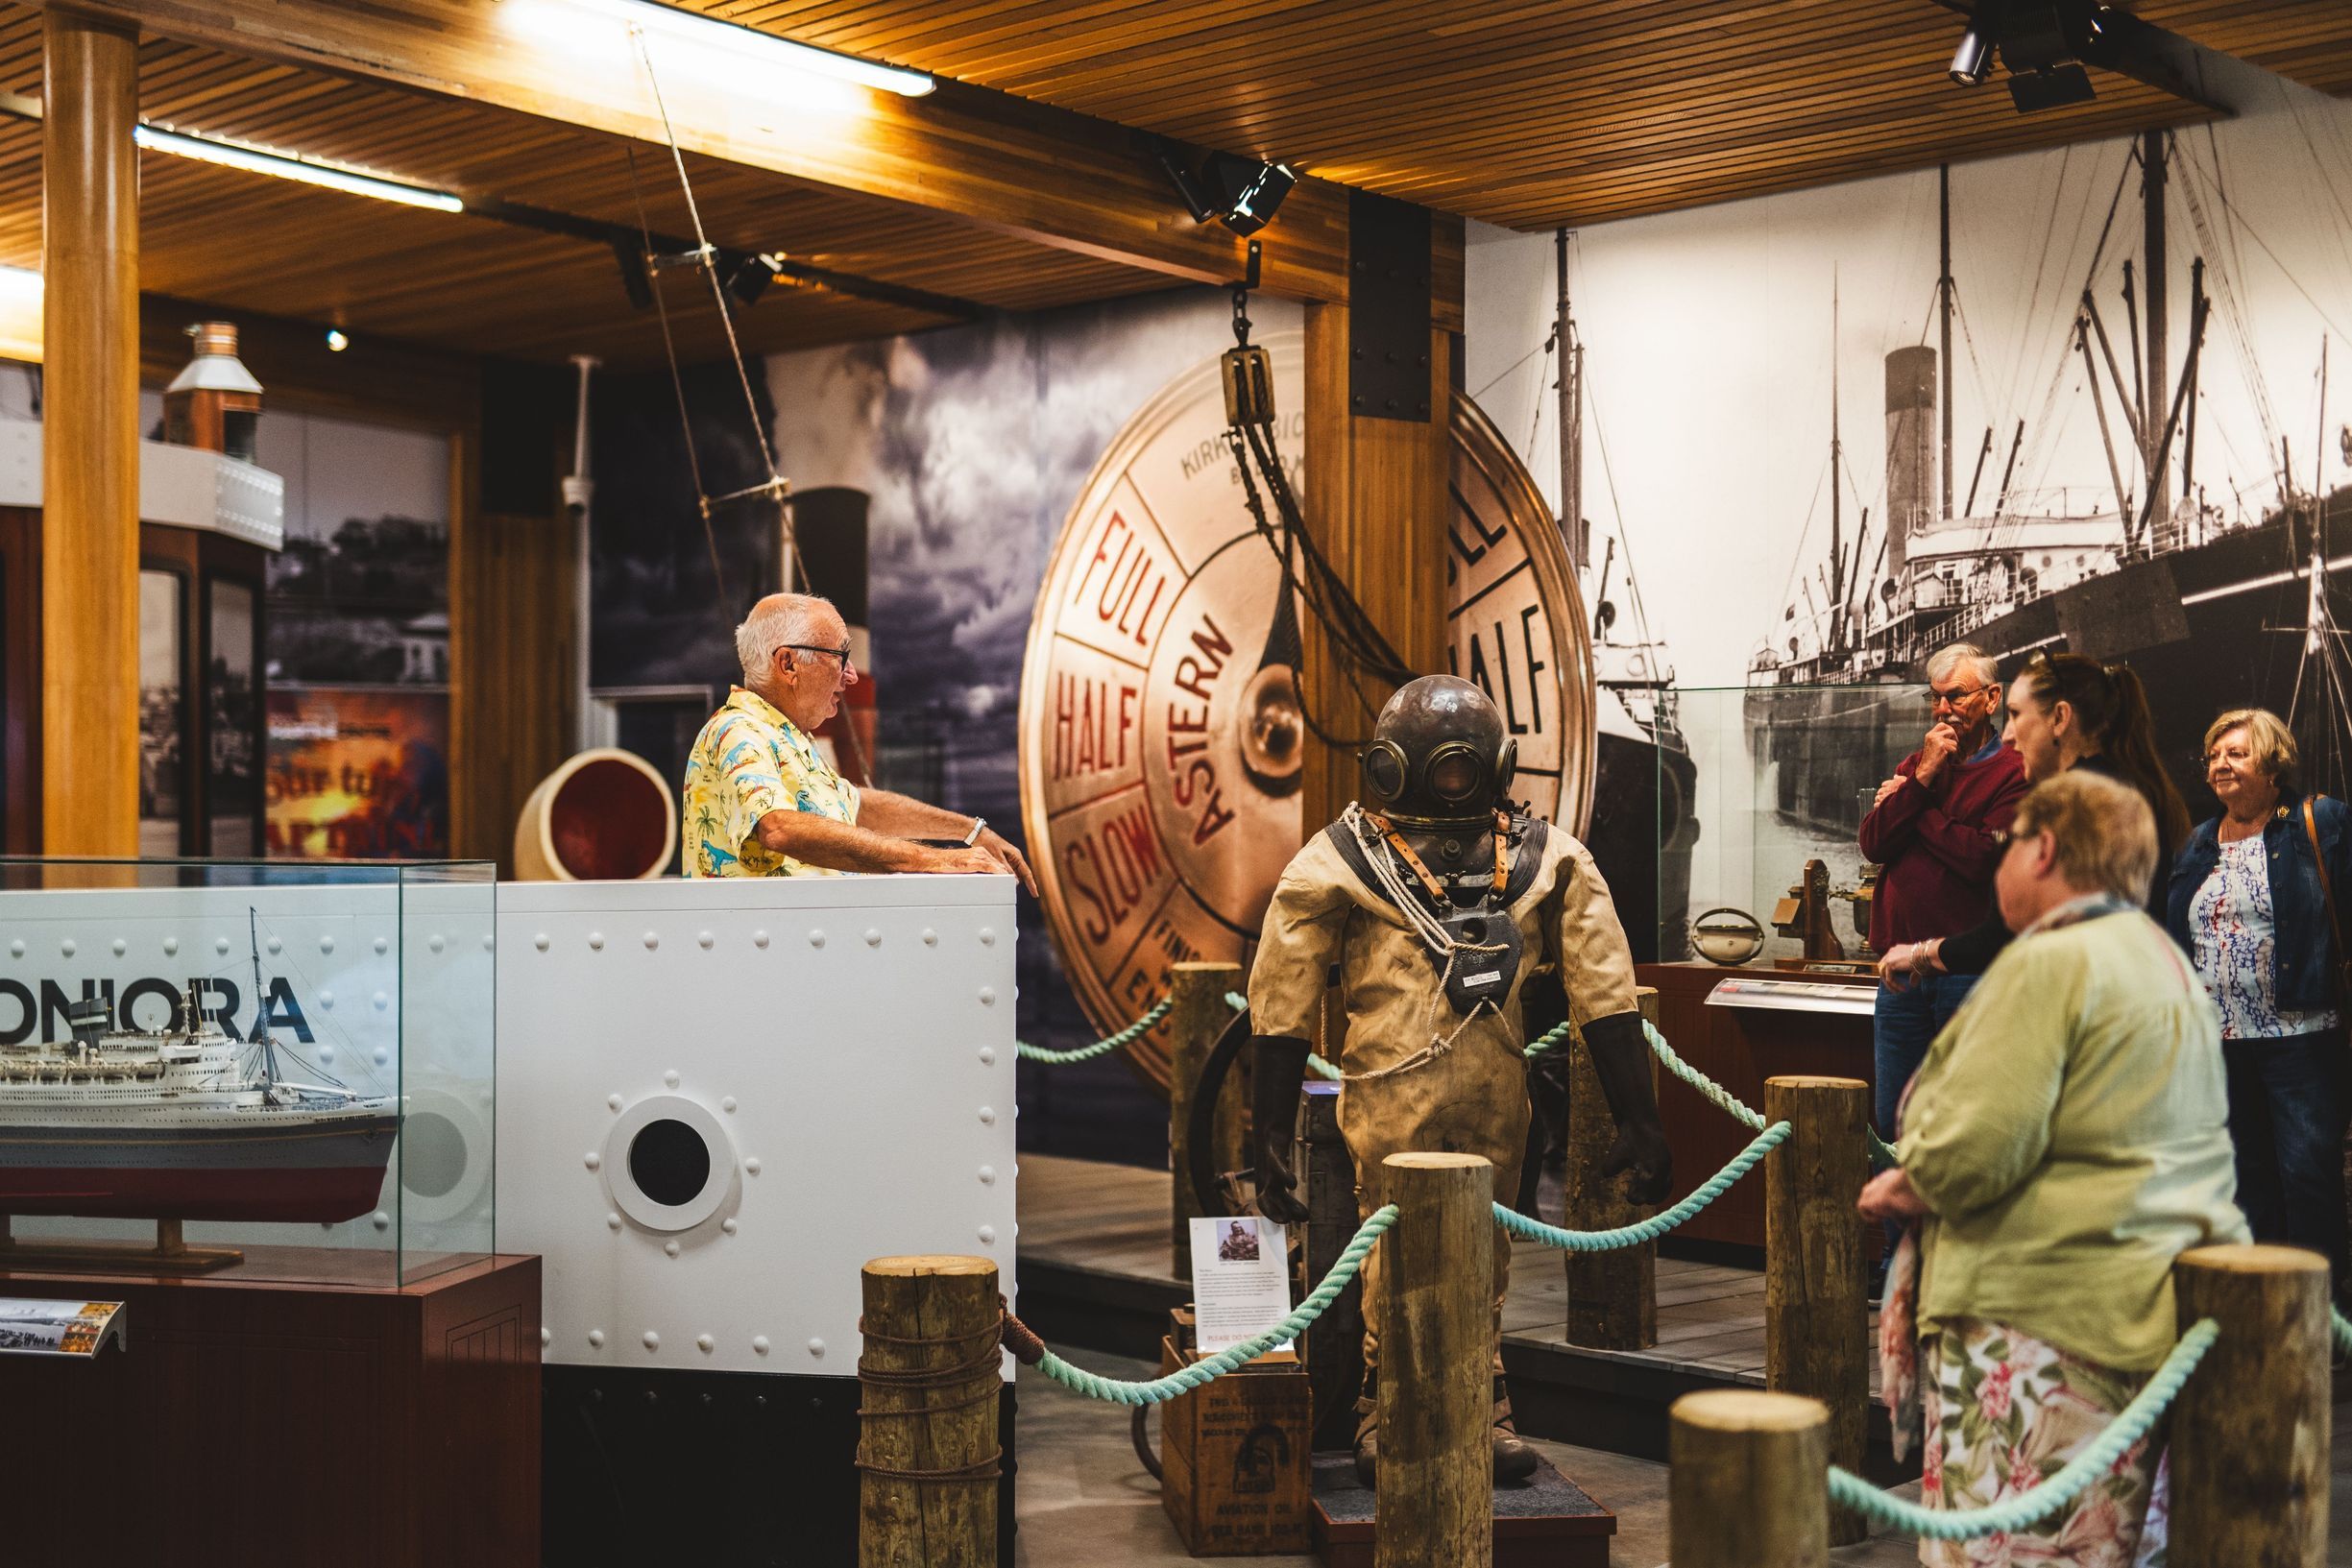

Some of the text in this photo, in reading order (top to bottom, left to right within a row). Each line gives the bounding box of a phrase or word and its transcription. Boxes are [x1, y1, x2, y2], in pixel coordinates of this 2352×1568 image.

[1075, 510, 1166, 647] FULL
[1448, 486, 1508, 588] LL
[1055, 670, 1137, 782] HALF
[1167, 613, 1234, 846] ASTERN
[1065, 802, 1162, 944] SLOW
